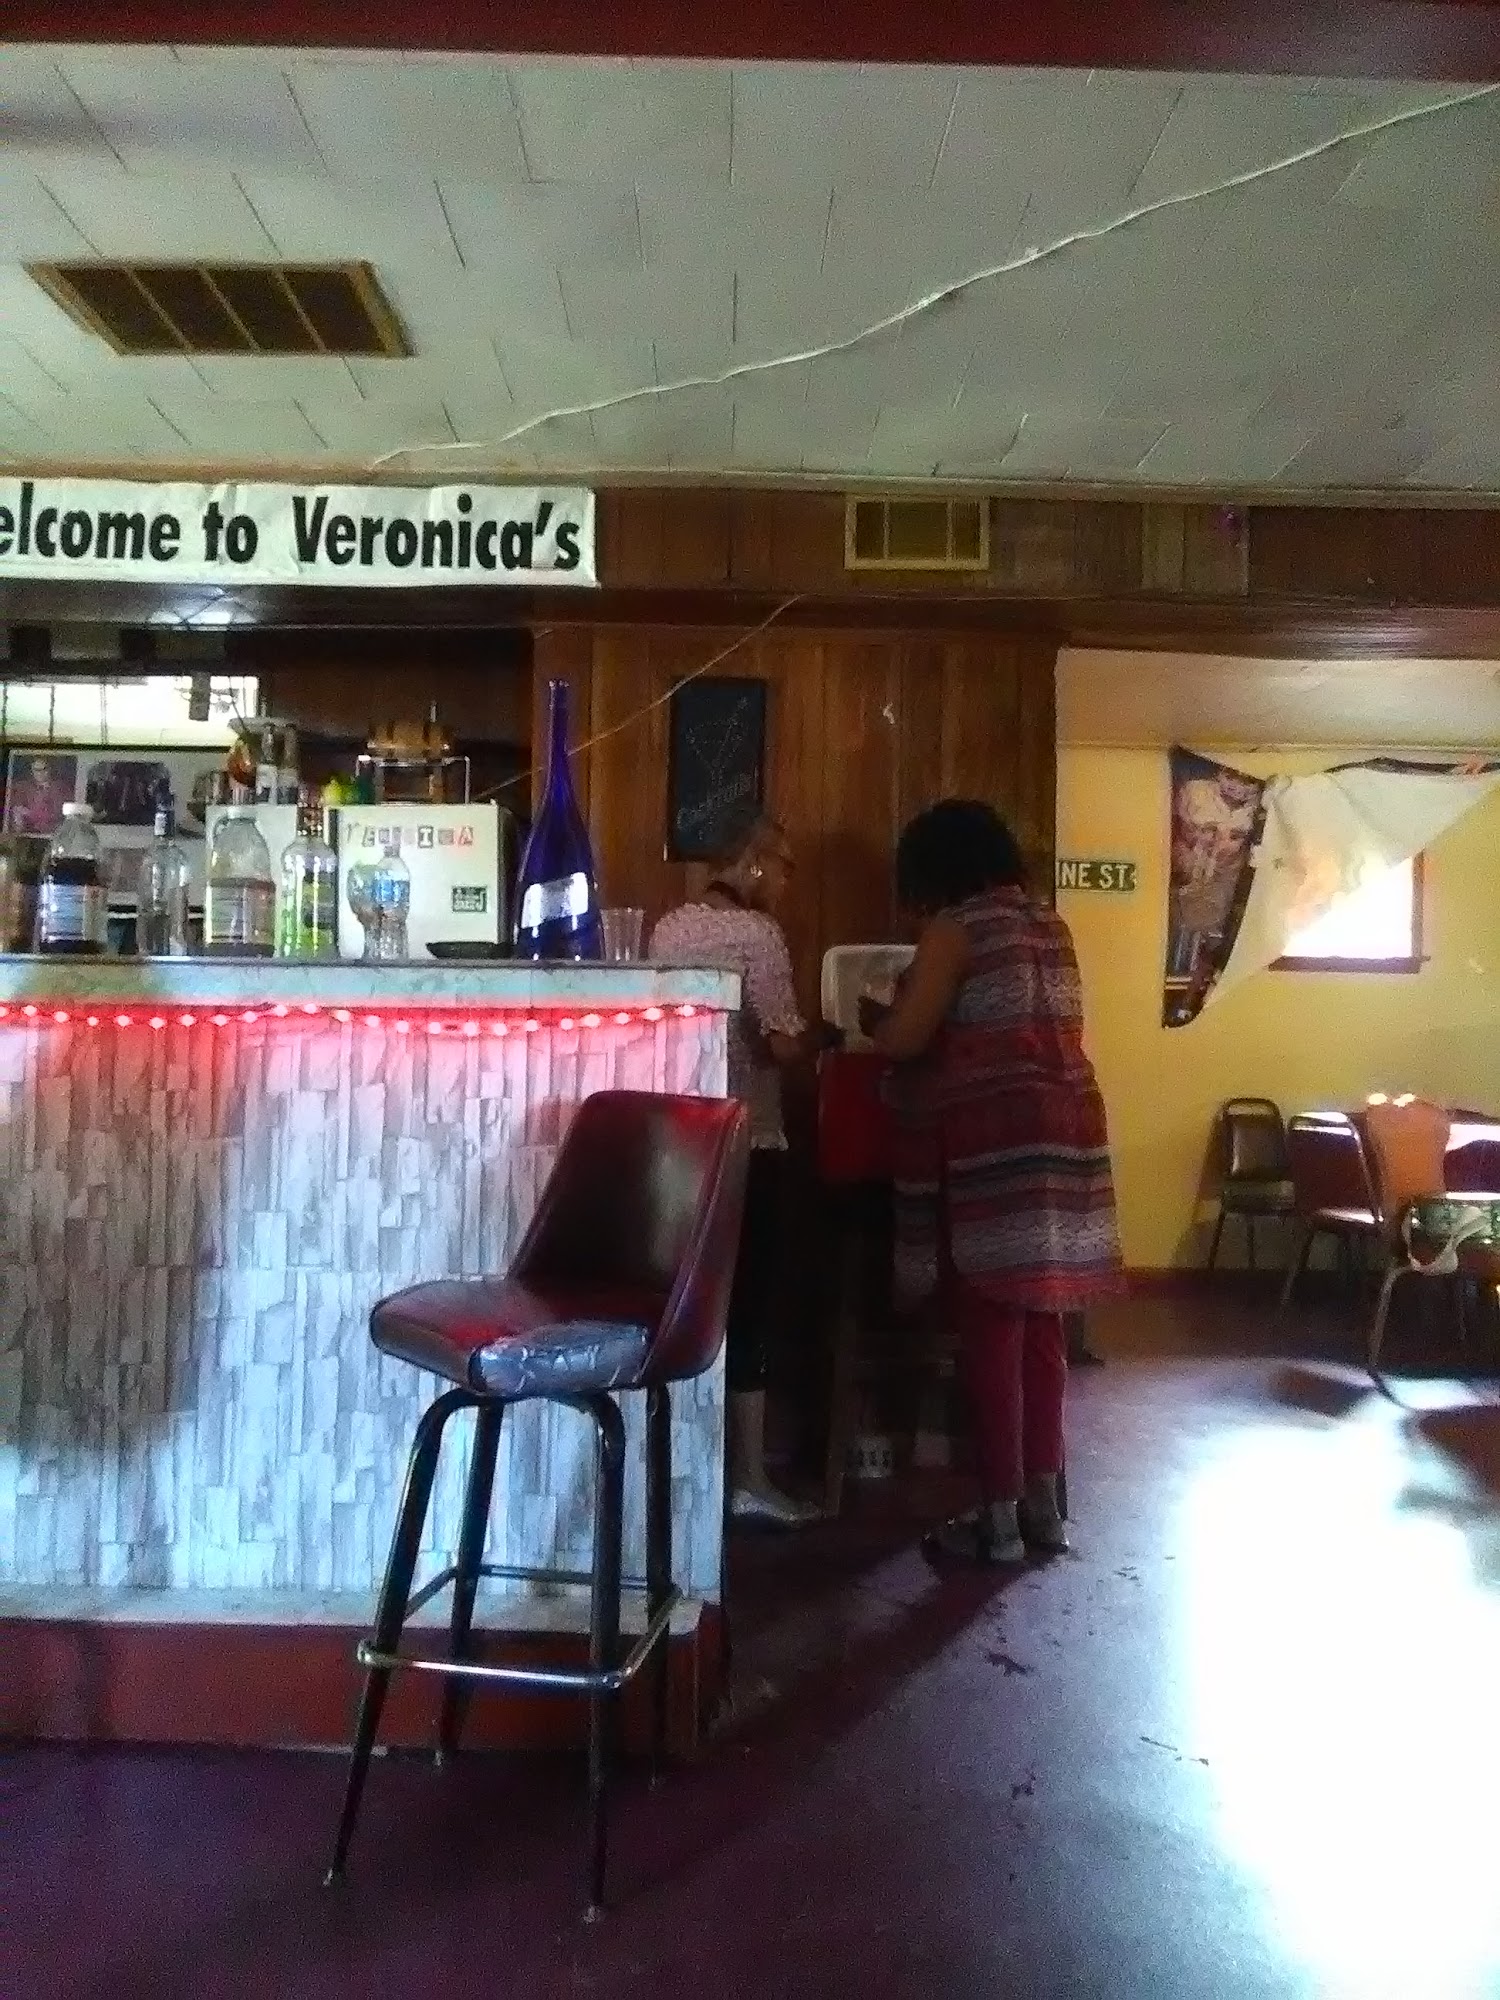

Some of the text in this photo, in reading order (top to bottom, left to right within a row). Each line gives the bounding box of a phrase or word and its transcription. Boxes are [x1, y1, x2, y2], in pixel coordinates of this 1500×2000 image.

[203, 502, 259, 565] to
[292, 493, 581, 571] Veronica's
[1099, 864, 1129, 889] ST
